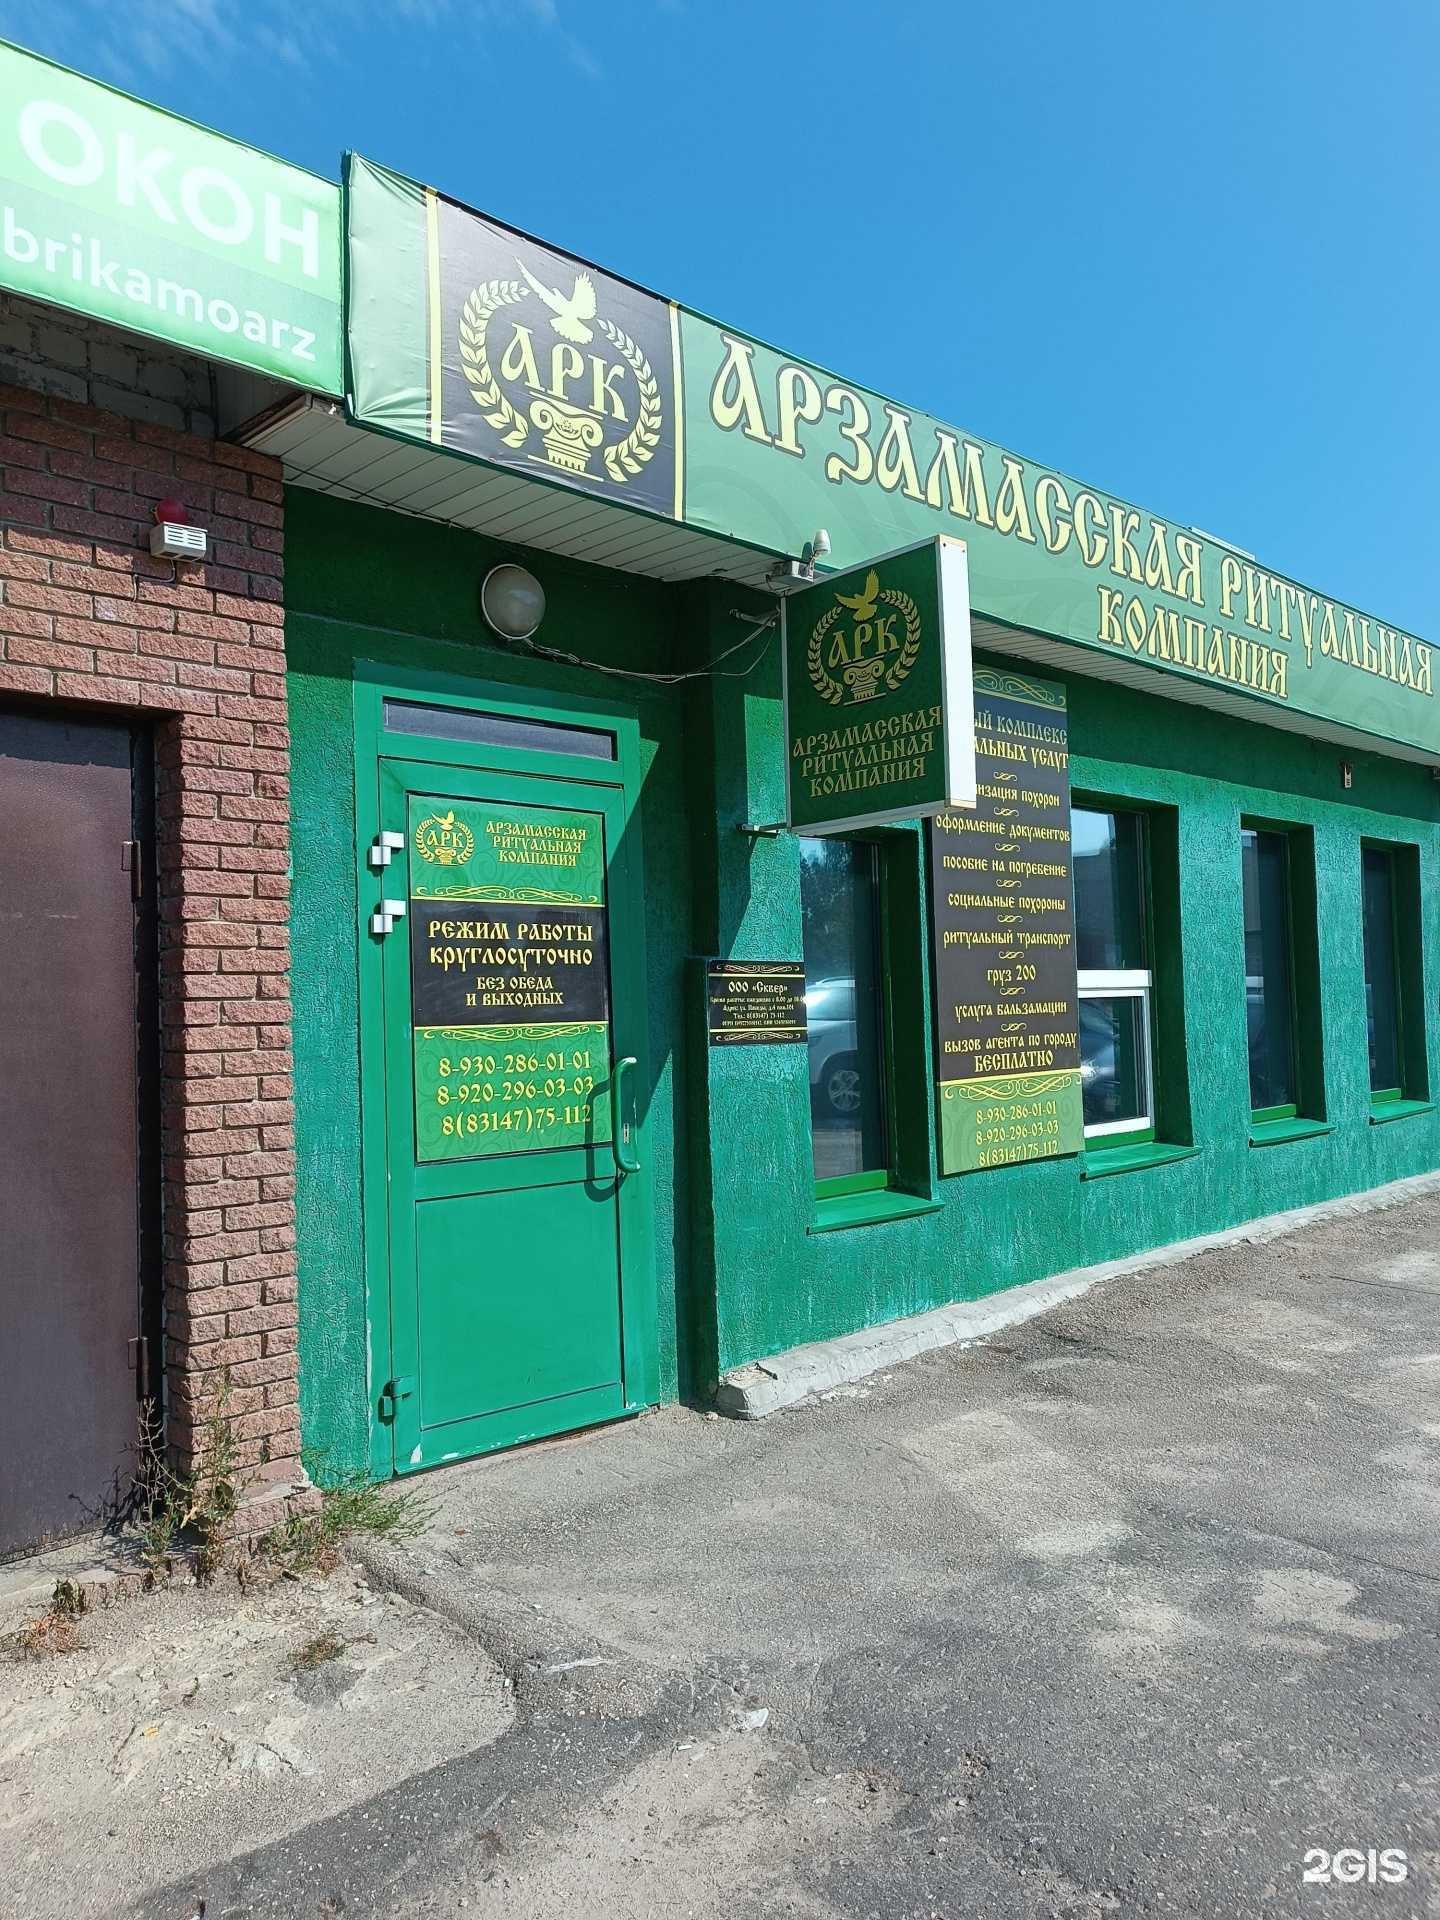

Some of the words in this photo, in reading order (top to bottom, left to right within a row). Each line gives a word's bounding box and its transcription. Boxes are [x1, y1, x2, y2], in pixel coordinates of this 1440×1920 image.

[19, 101, 319, 278] ОКОН
[4, 206, 316, 362] brikamoarz
[500, 323, 629, 423] АРК
[710, 333, 1204, 605] АРЗАМАССКАЯ
[1220, 556, 1434, 696] РИТУАЛЬНАЯ
[829, 613, 900, 668] АРК
[1097, 584, 1289, 699] КОМПАНИЯ
[793, 706, 944, 757] АРЗАМАССКАЯ
[997, 715, 1067, 745] КОМПЛЕКС
[802, 732, 935, 777] РИТУАЛЬНАЯ
[1031, 747, 1068, 773] УСЛУГ
[810, 757, 926, 797] КОМПАНИЯ
[1022, 791, 1060, 809] похорон
[427, 830, 464, 848] АРК
[486, 821, 587, 840] АРЗАМАССКАЯ
[1009, 824, 1070, 844] документов
[493, 836, 581, 853] РИТУАЛЬНАЯ
[499, 850, 576, 866] КОМПАНИЯ
[1019, 897, 1065, 914] похороны
[428, 921, 510, 940] РЕЖИМ
[517, 924, 593, 941] РАБОТЫ
[476, 977, 505, 990] БЕЗ
[510, 977, 553, 990] ОБЕДА
[728, 981, 749, 993] ООО
[987, 969, 1012, 985] груз
[1016, 965, 1035, 980] 200
[466, 994, 476, 1006] И
[482, 993, 564, 1007] ВЫХОДНЫХ
[1029, 1036, 1040, 1046] по
[439, 1051, 591, 1077] 8-930-286-01-01
[974, 1050, 1053, 1072] БЕСПЛАТНО
[437, 1076, 594, 1105] 8-920-296-03-03
[442, 1105, 590, 1138] 8(83147)75-112
[976, 1101, 1056, 1124] 8-930-286-01-01
[976, 1120, 1058, 1145] 8-920-296-03-03
